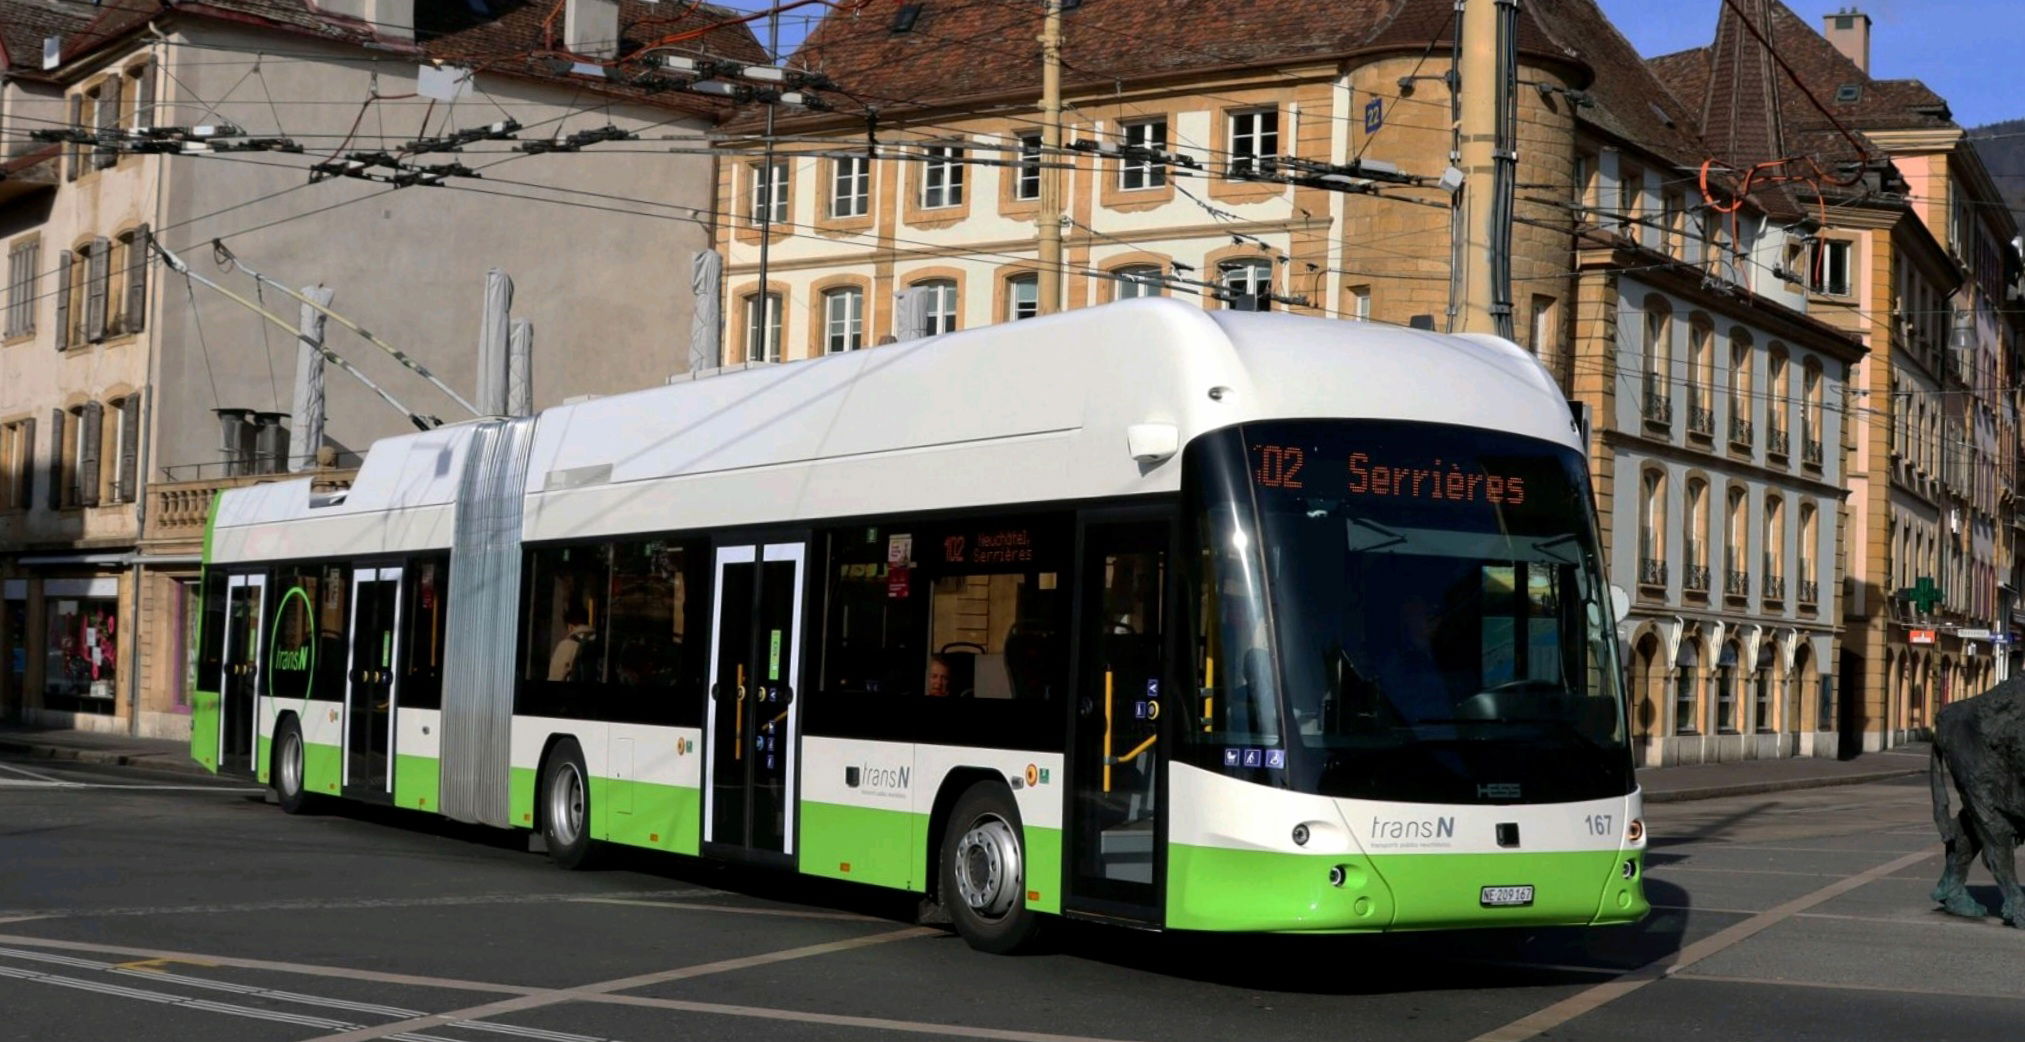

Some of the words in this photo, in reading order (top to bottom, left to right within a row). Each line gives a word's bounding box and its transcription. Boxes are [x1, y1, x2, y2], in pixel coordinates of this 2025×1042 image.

[1367, 106, 1380, 127] 22
[1349, 453, 1525, 504] Serrières
[944, 536, 966, 562] 102
[275, 643, 309, 671] transN
[862, 761, 910, 789] transN
[1476, 783, 1522, 799] HESS
[1371, 816, 1455, 839] transN
[1585, 814, 1612, 836] 167
